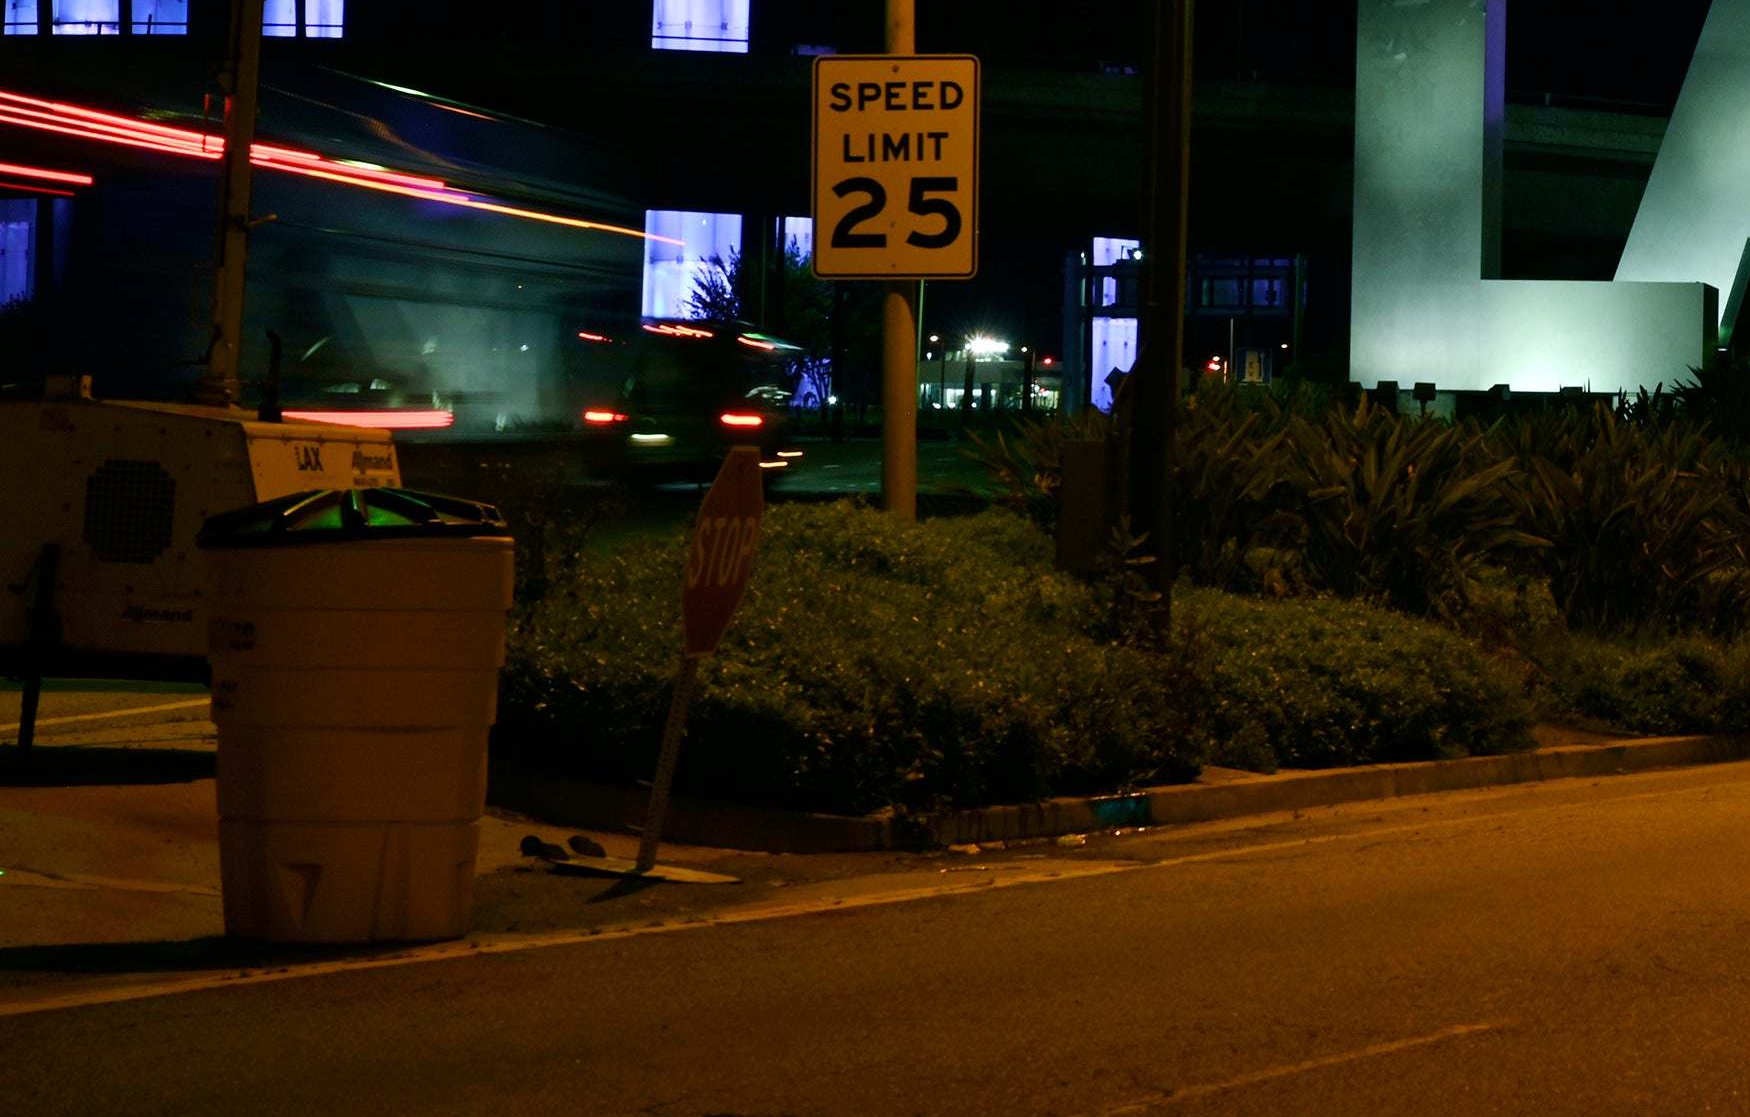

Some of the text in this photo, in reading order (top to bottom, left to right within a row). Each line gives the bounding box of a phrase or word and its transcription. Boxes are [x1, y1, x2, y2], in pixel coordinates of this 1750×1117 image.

[830, 82, 963, 111] SPEED
[844, 132, 949, 162] LIMIT
[831, 177, 962, 249] 25
[295, 445, 324, 472] LAX
[689, 516, 757, 589] STOP
[121, 605, 193, 622] Allmand
